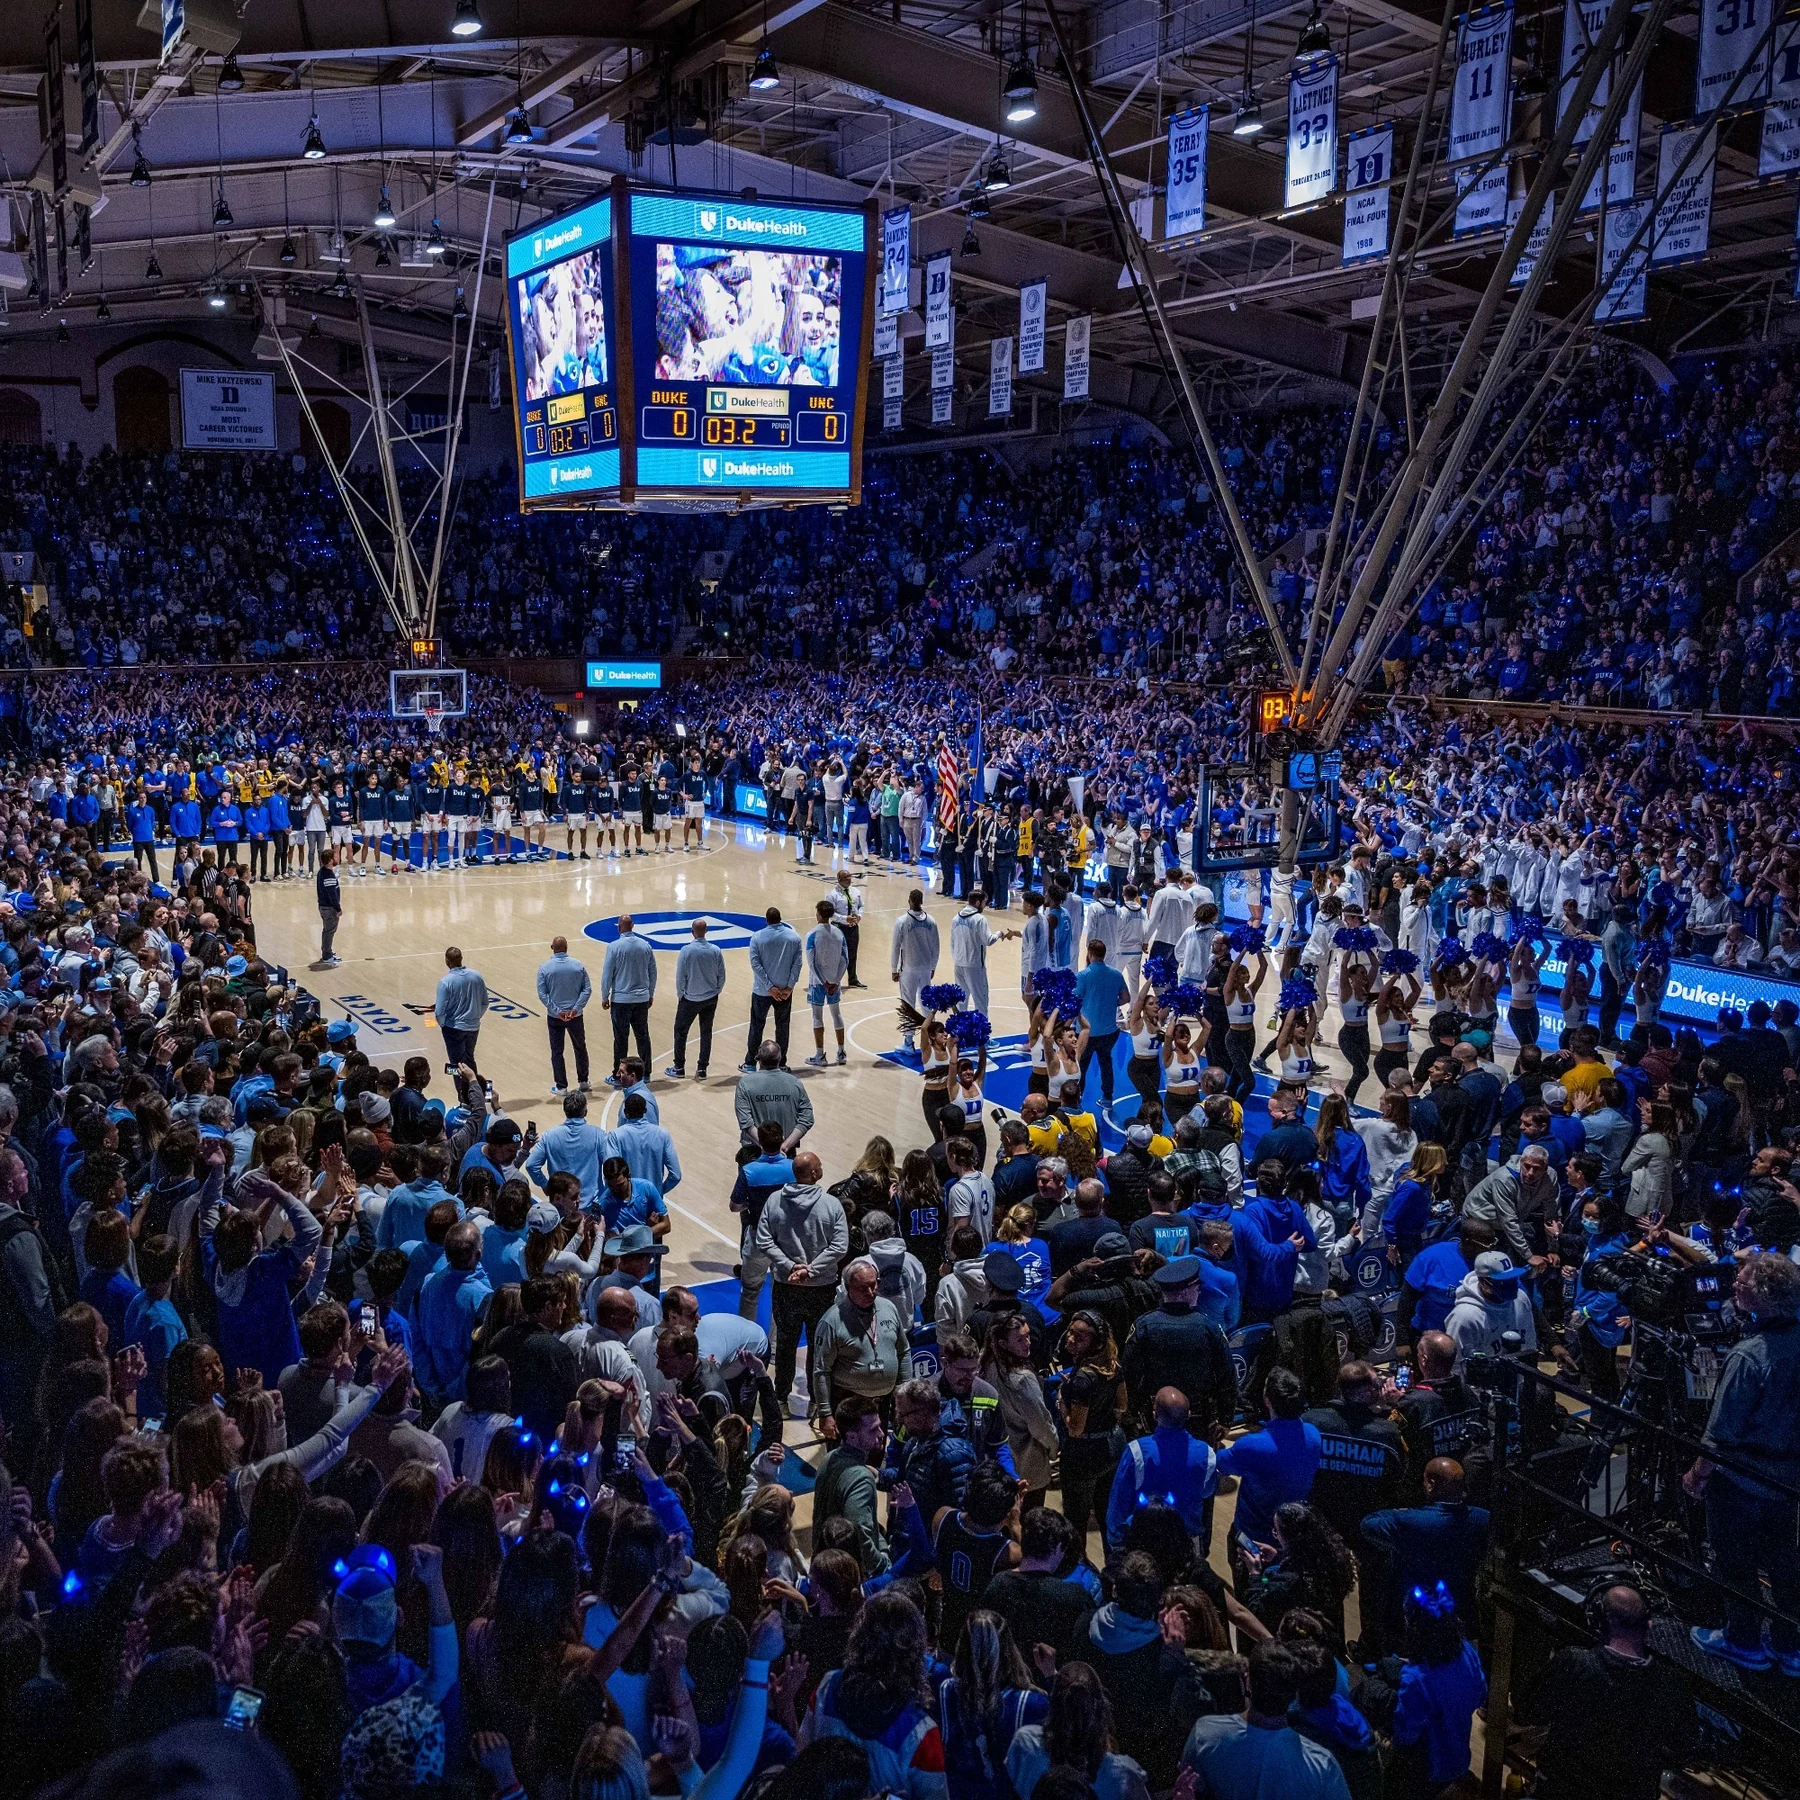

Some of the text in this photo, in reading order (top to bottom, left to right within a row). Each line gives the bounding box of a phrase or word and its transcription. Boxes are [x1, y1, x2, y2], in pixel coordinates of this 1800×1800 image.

[1461, 31, 1506, 65] HURLEY
[1469, 63, 1493, 101] 11
[1293, 85, 1333, 115] LAETTNER
[1297, 114, 1328, 150] 32
[1765, 120, 1794, 135] FINAL
[1174, 132, 1201, 154] FERRY
[1609, 151, 1634, 166] FOUR
[1780, 149, 1800, 162] 199
[1173, 155, 1199, 186] 35
[1483, 176, 1506, 191] FOUR
[1358, 196, 1376, 209] NCAA
[1346, 210, 1386, 227] FINAL FOUR
[1470, 207, 1490, 219] 1989
[726, 216, 807, 236] DukeHealth
[545, 225, 582, 251] DukeHealth
[1356, 238, 1373, 249] 1988
[1668, 239, 1690, 250] 1965
[888, 244, 906, 270] 24
[196, 376, 262, 386] MIKE KRZYZEWSKI
[651, 391, 688, 405] DUKE
[731, 398, 785, 408] DukeHealth
[809, 397, 835, 409] UNC
[222, 416, 241, 424] MOST
[604, 412, 612, 437] 0
[673, 410, 688, 436] 0
[772, 422, 790, 430] PERIOD
[824, 415, 838, 440] 0
[199, 424, 264, 434] CAREER VICTORIES
[707, 418, 756, 444] 03.2
[780, 430, 786, 442] 1
[208, 436, 234, 444] NOVEMBER
[536, 426, 544, 450] 0
[550, 426, 573, 452] 03.2
[583, 433, 587, 445] 1
[560, 465, 592, 482] DukeHealth
[724, 462, 794, 476] DukeHealth
[608, 670, 656, 680] DukeHealth
[755, 1094, 790, 1103] SECURITY
[981, 1190, 990, 1216] 3
[909, 1208, 938, 1236] 15
[1156, 1228, 1188, 1238] NAUTICA
[454, 1437, 464, 1479] 1
[1322, 1438, 1386, 1464] URHAM
[1330, 1460, 1384, 1478] DEPARTMENT
[952, 1550, 972, 1592] 0
